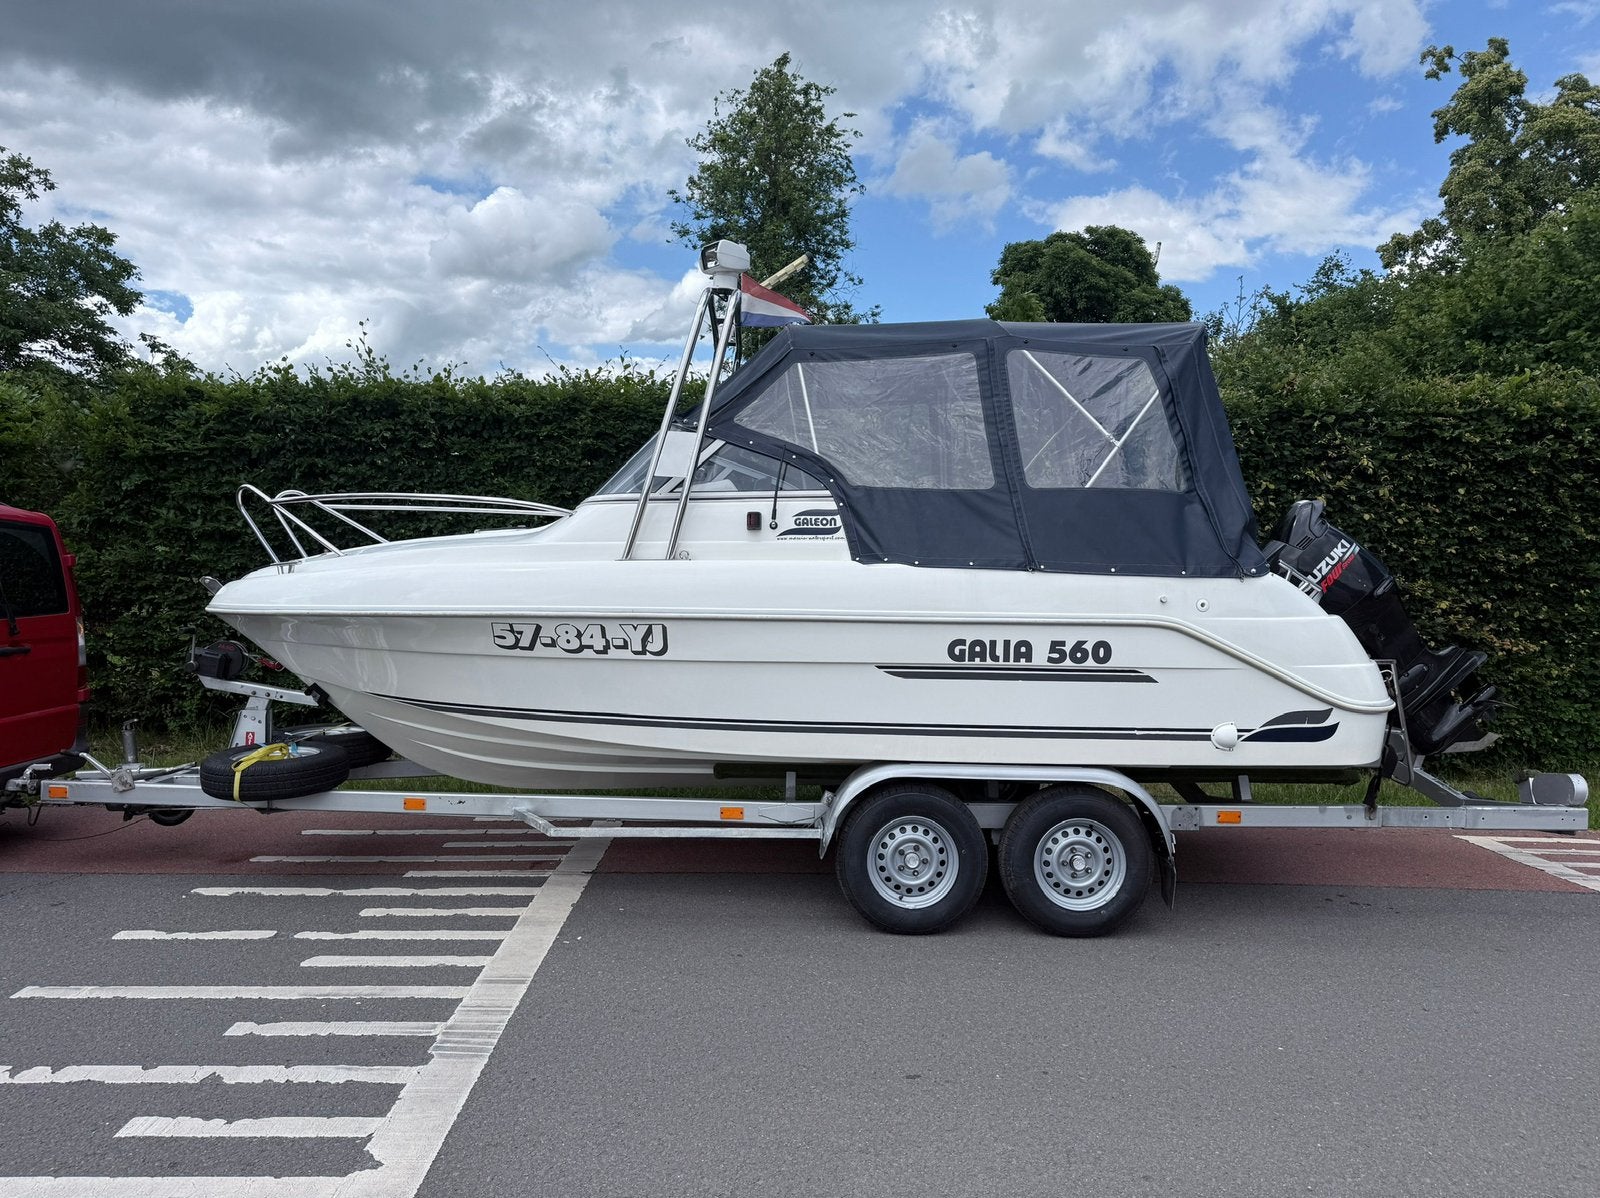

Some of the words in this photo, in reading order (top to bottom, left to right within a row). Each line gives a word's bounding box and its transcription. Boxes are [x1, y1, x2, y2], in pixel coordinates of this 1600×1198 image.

[794, 517, 837, 527] GALEON
[1303, 539, 1351, 587] UZUKI
[491, 622, 669, 656] 57-84-YJ
[947, 638, 1033, 663] GALIA
[1046, 640, 1113, 665] 560
